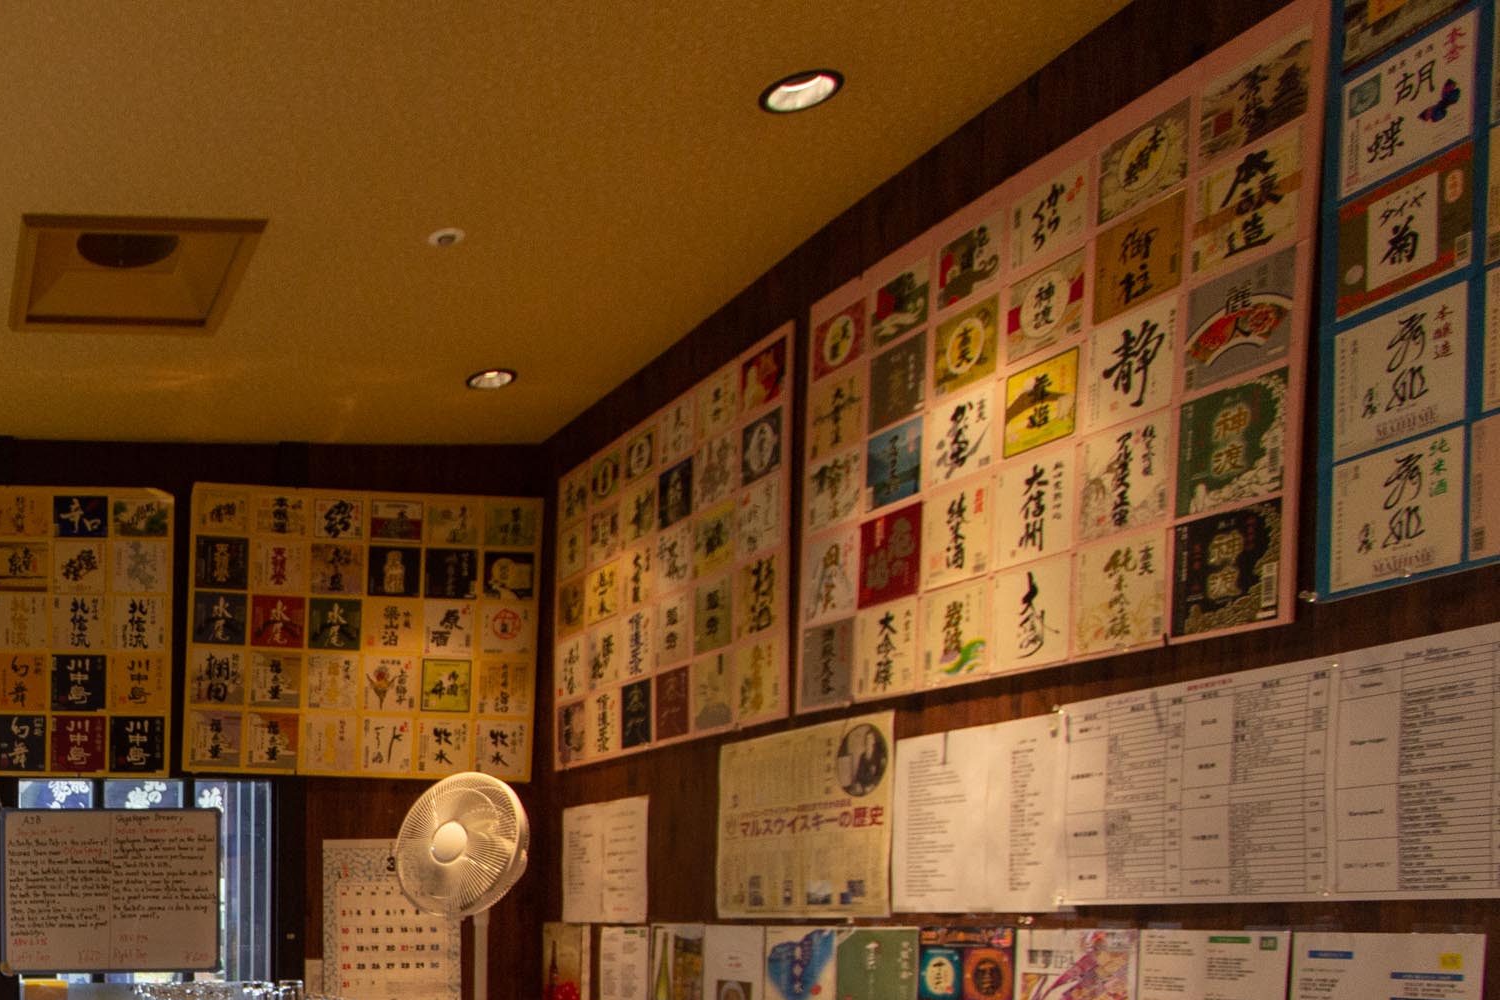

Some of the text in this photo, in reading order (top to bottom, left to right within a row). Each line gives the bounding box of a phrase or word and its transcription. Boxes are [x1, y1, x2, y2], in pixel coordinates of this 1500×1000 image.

[1380, 191, 1426, 227] ダイヤ
[1381, 216, 1419, 267] 菊
[1103, 320, 1165, 407] 静
[1211, 403, 1248, 476] 神渡
[946, 491, 967, 570] 純米酒
[1019, 464, 1049, 551] 大信州
[1206, 529, 1245, 600] 神渡
[70, 597, 90, 648] 北信流
[128, 599, 148, 648] 北信流
[66, 657, 92, 705] 川中島
[127, 659, 152, 704] 川中島
[66, 719, 91, 766] 川中島
[125, 719, 152, 766] 川中島
[386, 856, 396, 872] 3
